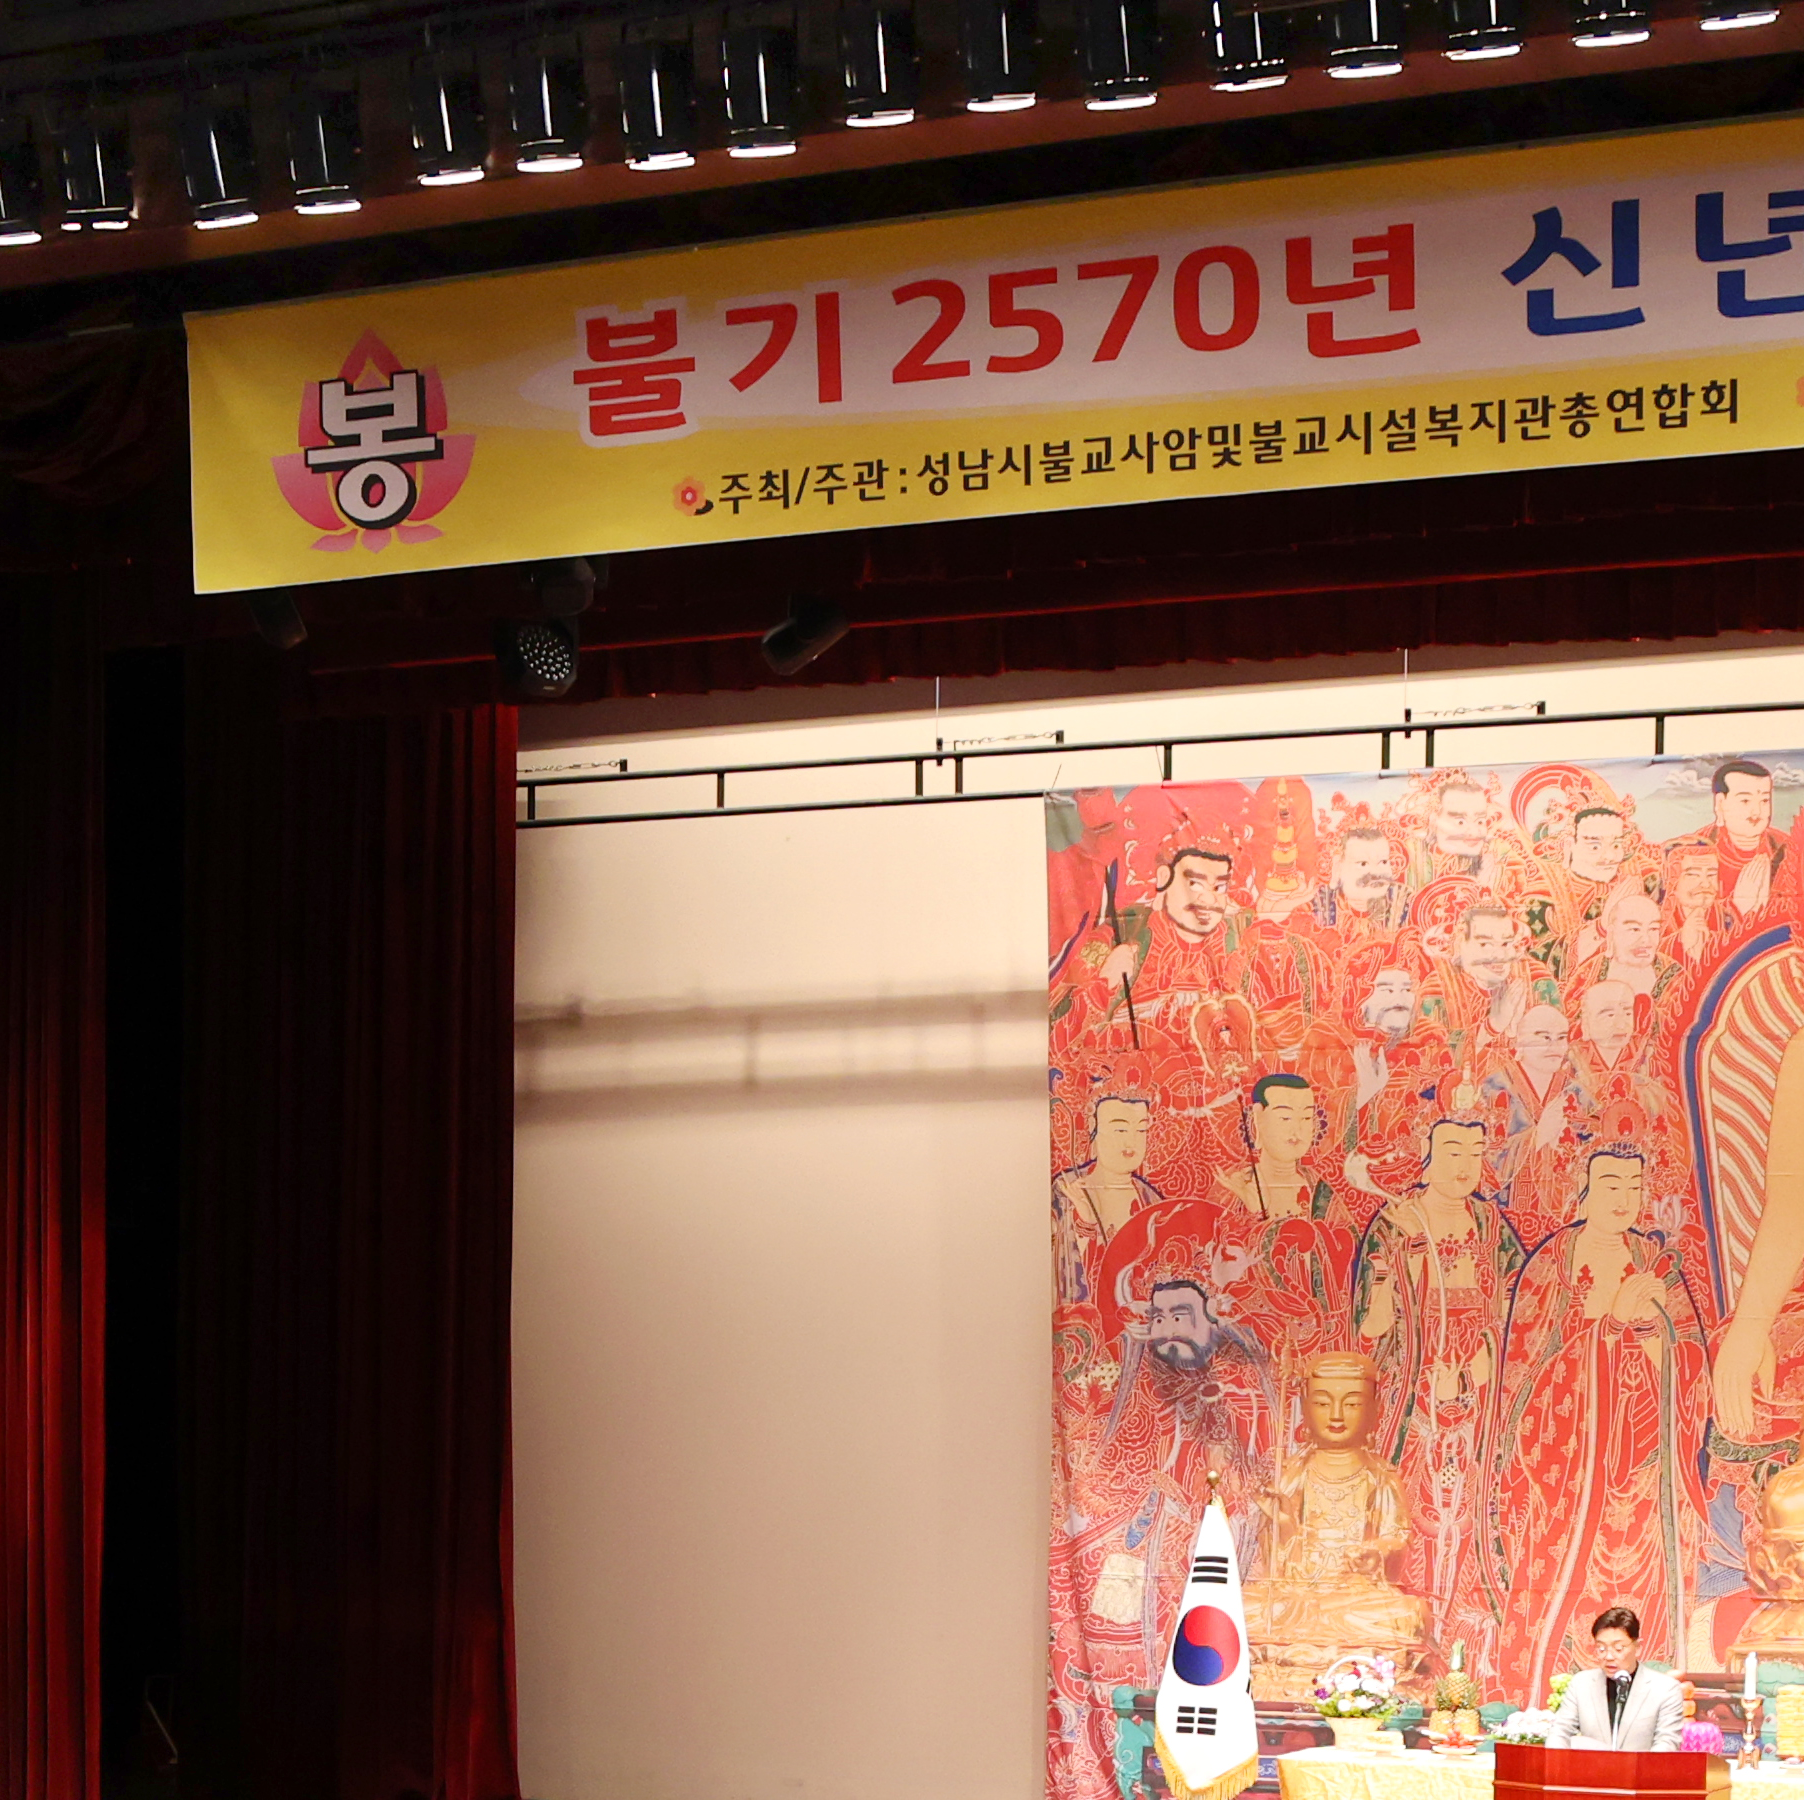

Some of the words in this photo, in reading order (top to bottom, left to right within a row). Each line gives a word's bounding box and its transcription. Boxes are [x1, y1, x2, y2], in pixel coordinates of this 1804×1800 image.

[573, 291, 844, 437] 불기
[891, 223, 1422, 385] 2570년
[304, 369, 444, 530] 봉
